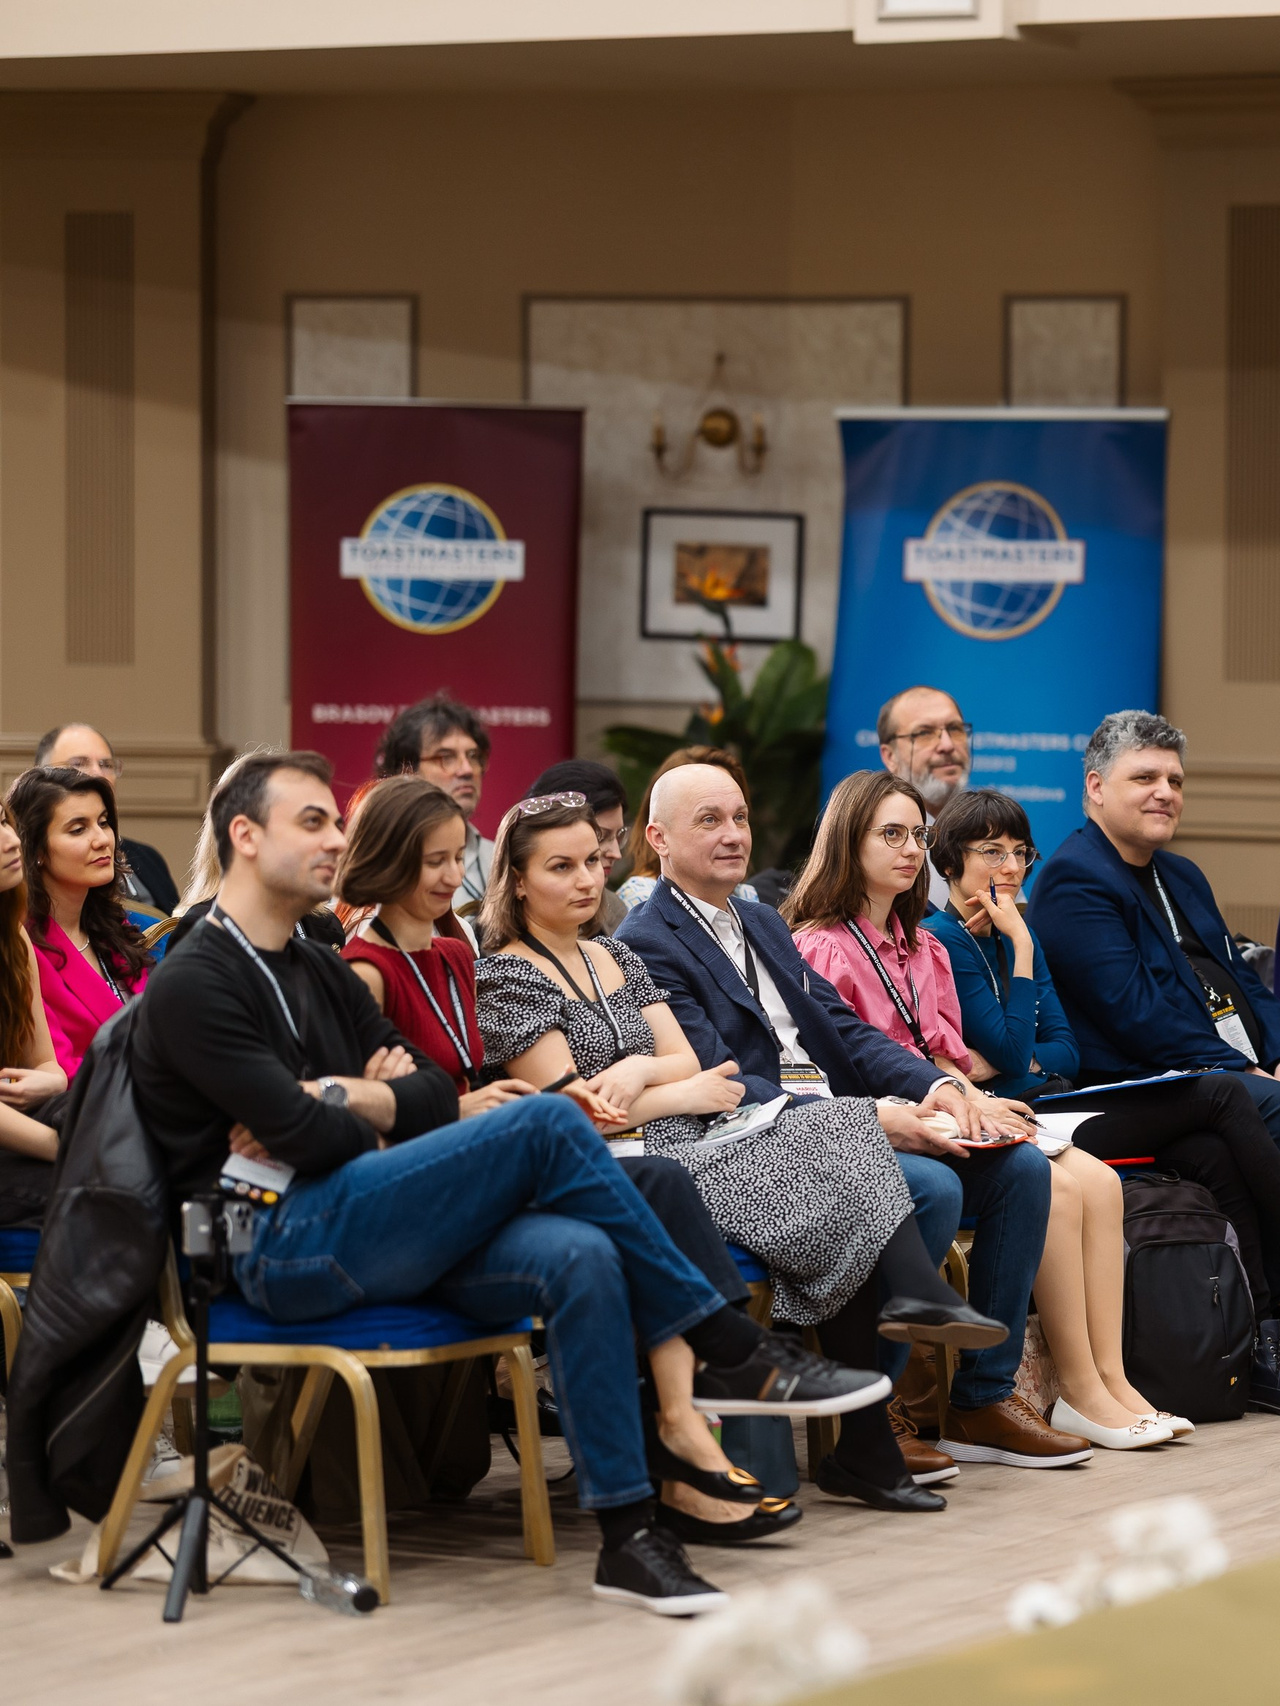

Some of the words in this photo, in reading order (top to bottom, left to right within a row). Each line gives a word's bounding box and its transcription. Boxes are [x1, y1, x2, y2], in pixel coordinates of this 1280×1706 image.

[350, 546, 517, 562] TOASTMASTERS
[914, 548, 1076, 562] TOASTMASTERS
[311, 703, 394, 724] BRASOV
